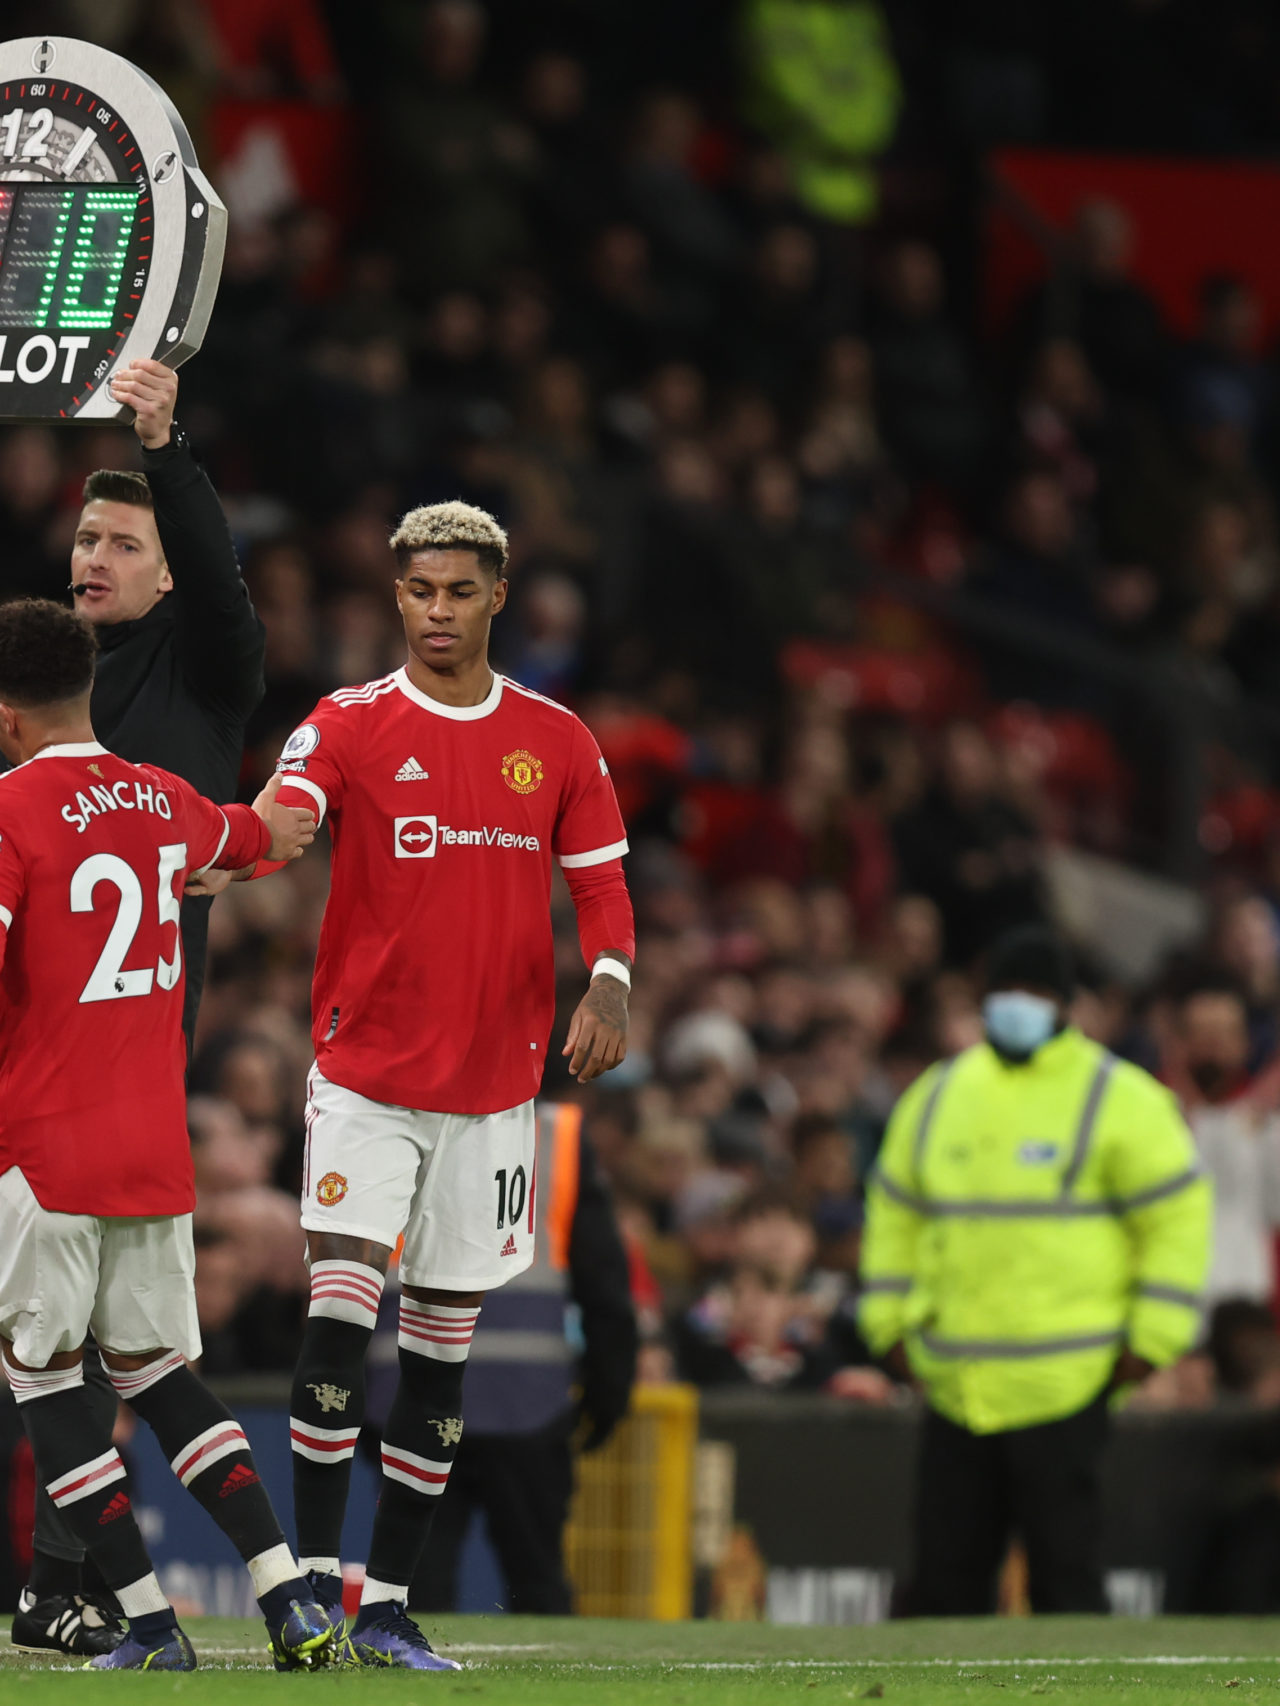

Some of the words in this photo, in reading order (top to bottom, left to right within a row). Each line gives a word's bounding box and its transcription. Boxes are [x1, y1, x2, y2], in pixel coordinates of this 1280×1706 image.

[30, 84, 46, 96] 60
[96, 107, 111, 124] 05
[1, 107, 54, 157] 12
[33, 190, 141, 328] 10
[133, 269, 145, 288] 15
[93, 360, 109, 379] 20
[394, 771, 429, 782] adidas
[61, 780, 172, 833] SANCHO
[69, 842, 188, 1004] 25
[495, 1165, 526, 1229] 10
[98, 1503, 131, 1525] adida
